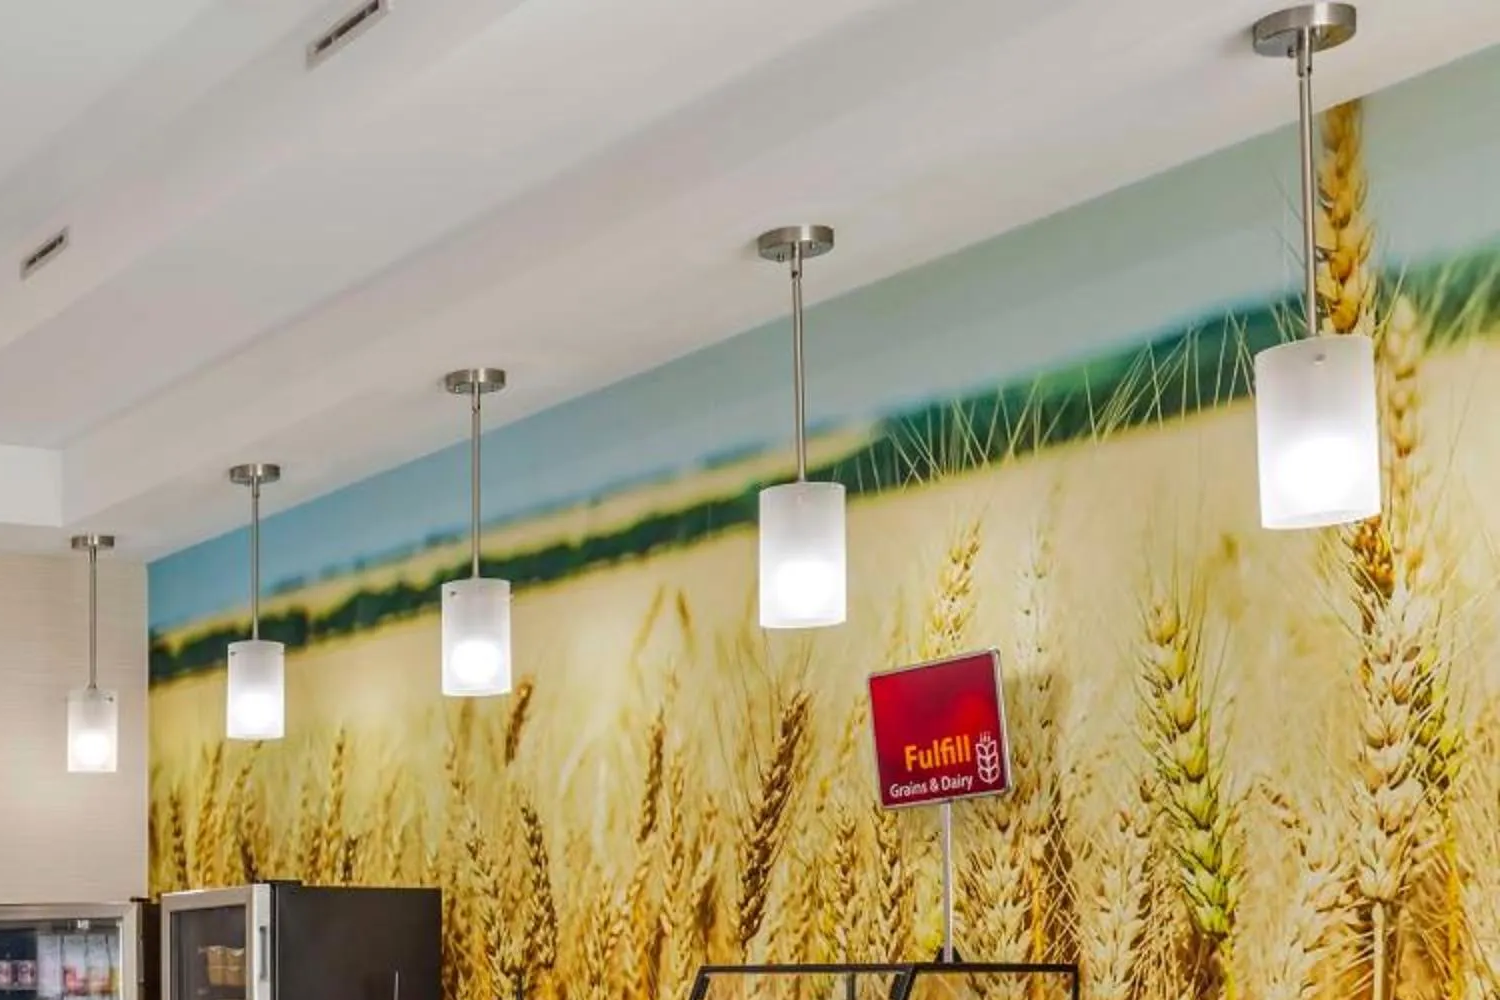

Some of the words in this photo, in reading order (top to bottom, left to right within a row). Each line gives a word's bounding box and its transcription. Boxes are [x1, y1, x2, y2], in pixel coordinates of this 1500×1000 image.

[904, 734, 971, 771] Fulfill
[889, 780, 928, 797] Grains
[929, 777, 939, 793] &
[941, 773, 974, 791] Dairy
